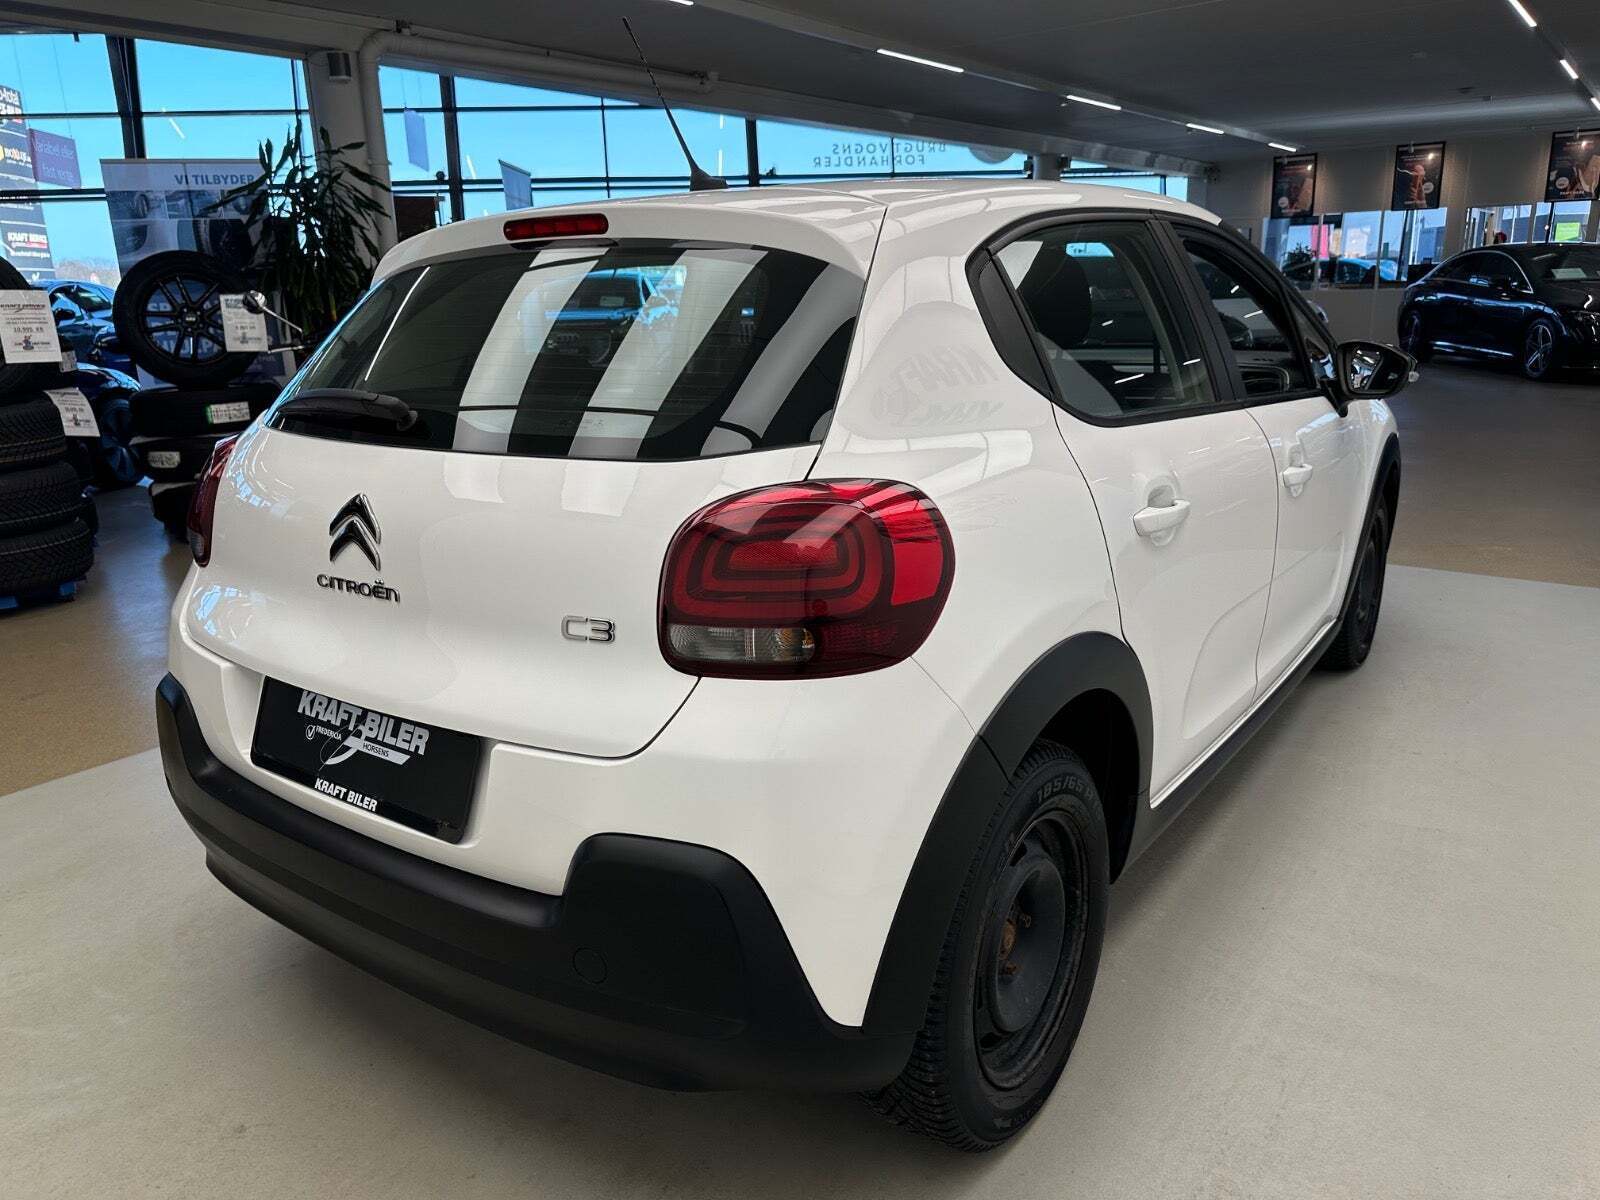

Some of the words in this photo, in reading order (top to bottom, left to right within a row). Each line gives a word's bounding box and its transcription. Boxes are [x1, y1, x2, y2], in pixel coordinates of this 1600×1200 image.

[174, 174, 189, 185] VI
[560, 615, 616, 643] C3
[297, 689, 363, 731] KRAFT
[364, 711, 430, 756] BILER
[362, 742, 390, 757] HORSENS
[314, 777, 347, 799] KRAFT
[346, 790, 379, 812] BILER
